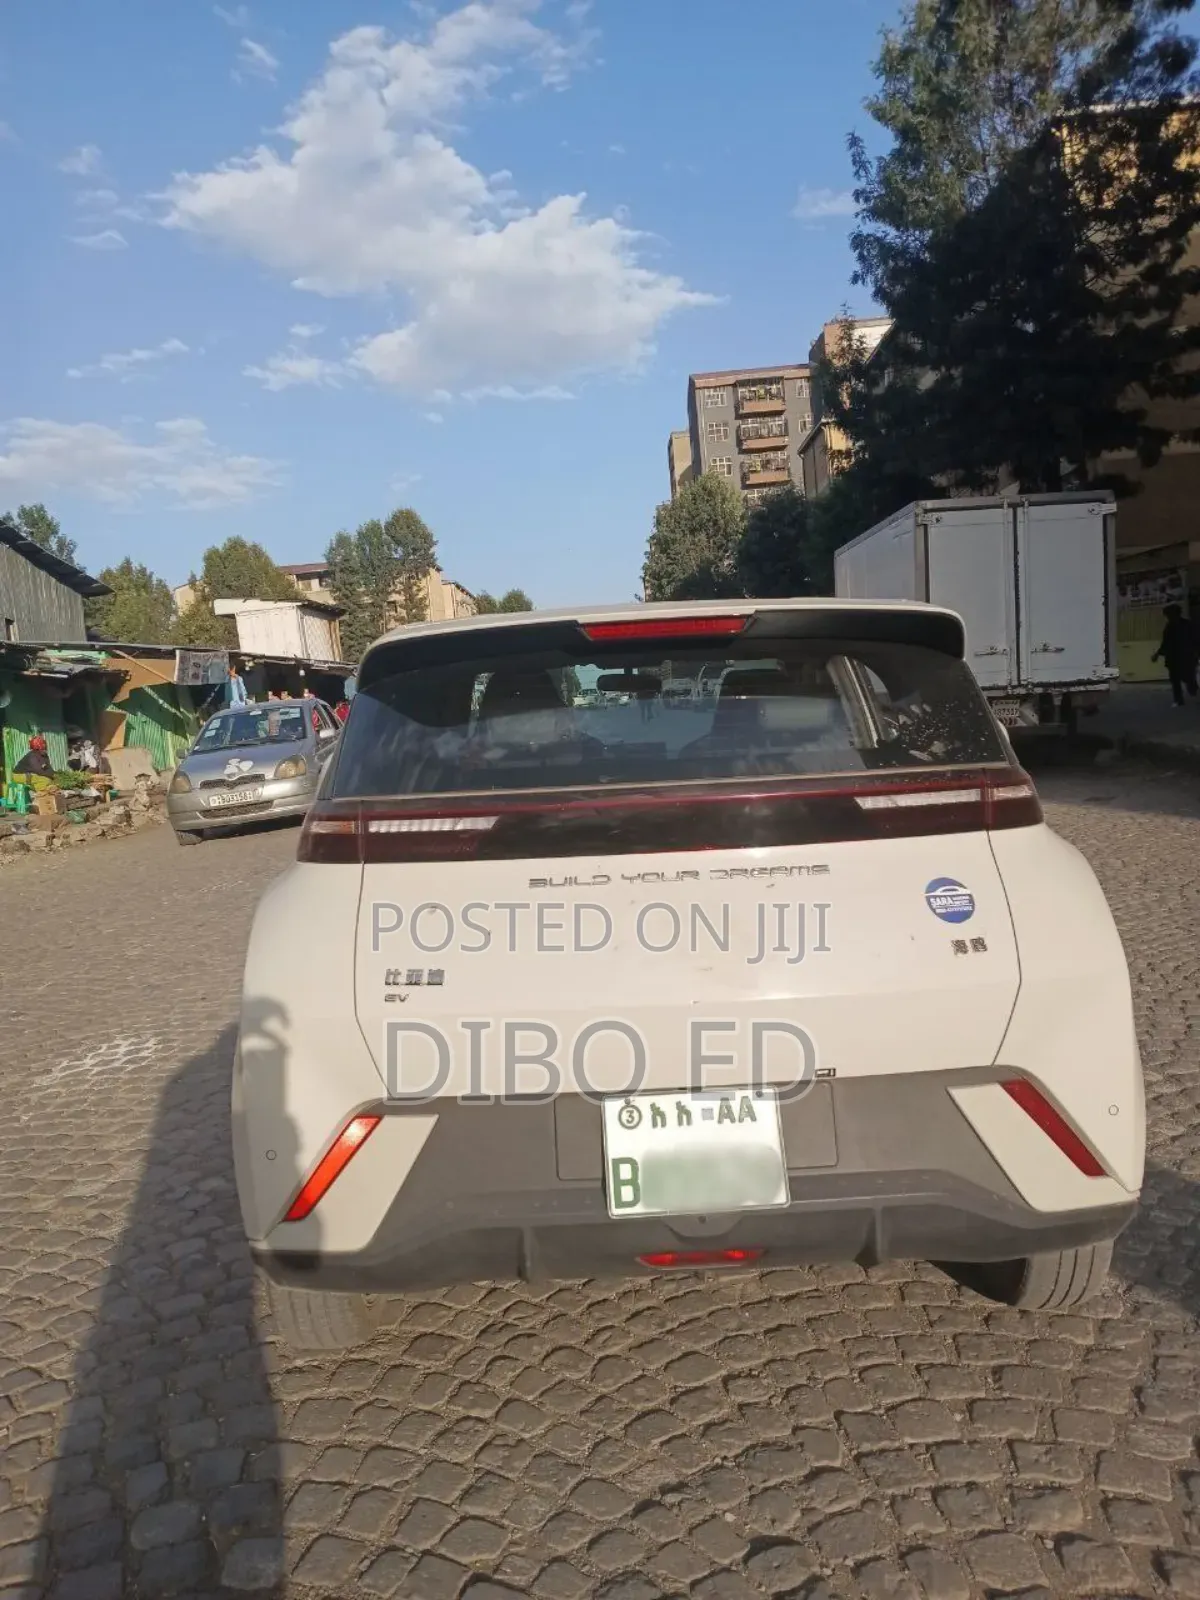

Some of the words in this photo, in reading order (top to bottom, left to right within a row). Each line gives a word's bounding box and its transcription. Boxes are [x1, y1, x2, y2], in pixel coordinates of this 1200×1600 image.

[528, 874, 612, 888] BUILD
[621, 869, 700, 884] YOUR
[709, 864, 831, 880] DREAMS
[384, 993, 410, 1003] EV
[717, 1095, 757, 1124] AA
